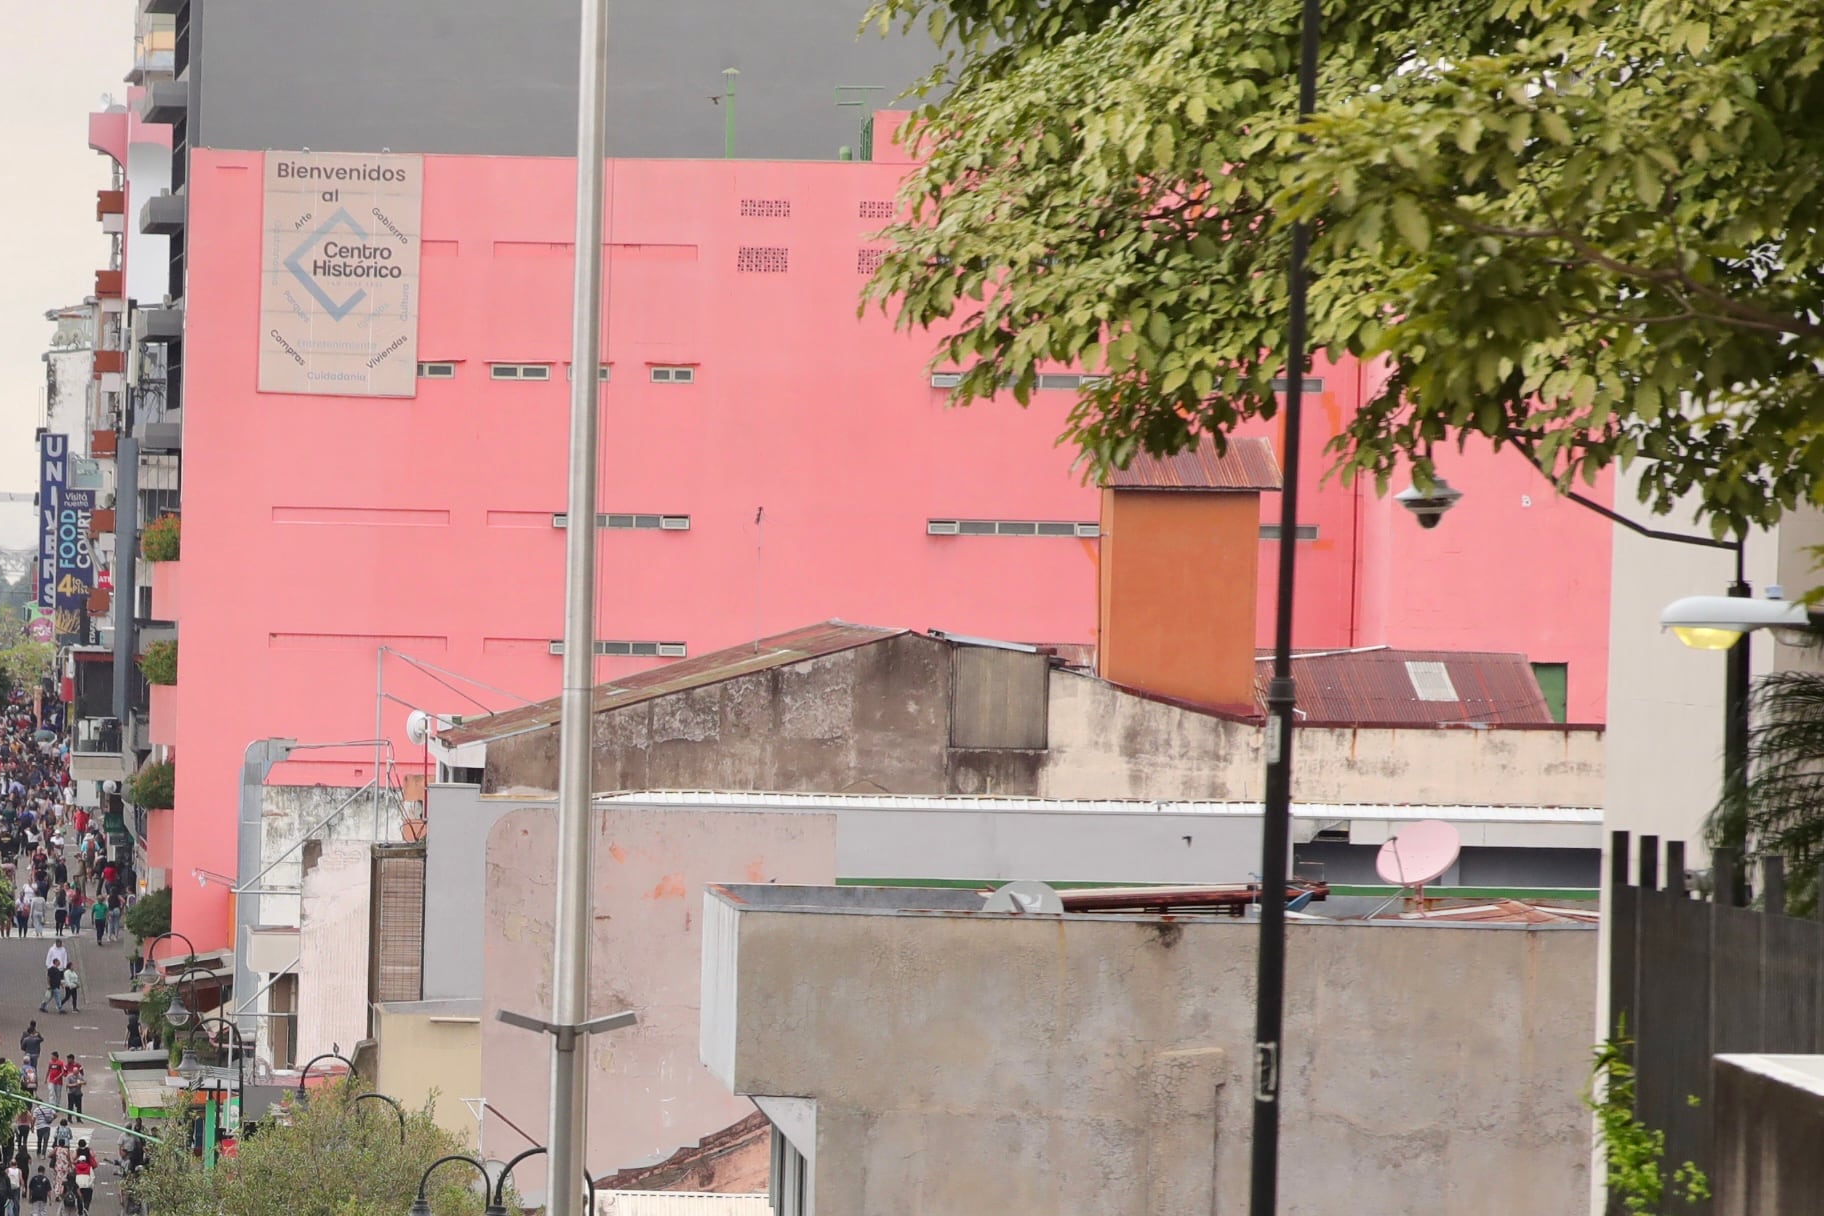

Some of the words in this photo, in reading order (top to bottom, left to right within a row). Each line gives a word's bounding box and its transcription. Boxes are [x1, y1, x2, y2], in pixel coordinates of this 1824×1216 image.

[277, 162, 406, 182] Bienvenidos
[322, 189, 339, 202] al
[294, 212, 312, 230] Arte
[371, 207, 408, 245] Gobierno
[324, 241, 392, 260] Centro
[313, 260, 402, 279] Histórico
[284, 290, 310, 325] Parques
[400, 283, 409, 321] Cultura
[270, 329, 306, 366] Compras
[366, 334, 408, 369] Viviendas
[59, 510, 76, 568] FOOD
[77, 509, 92, 568] COURT
